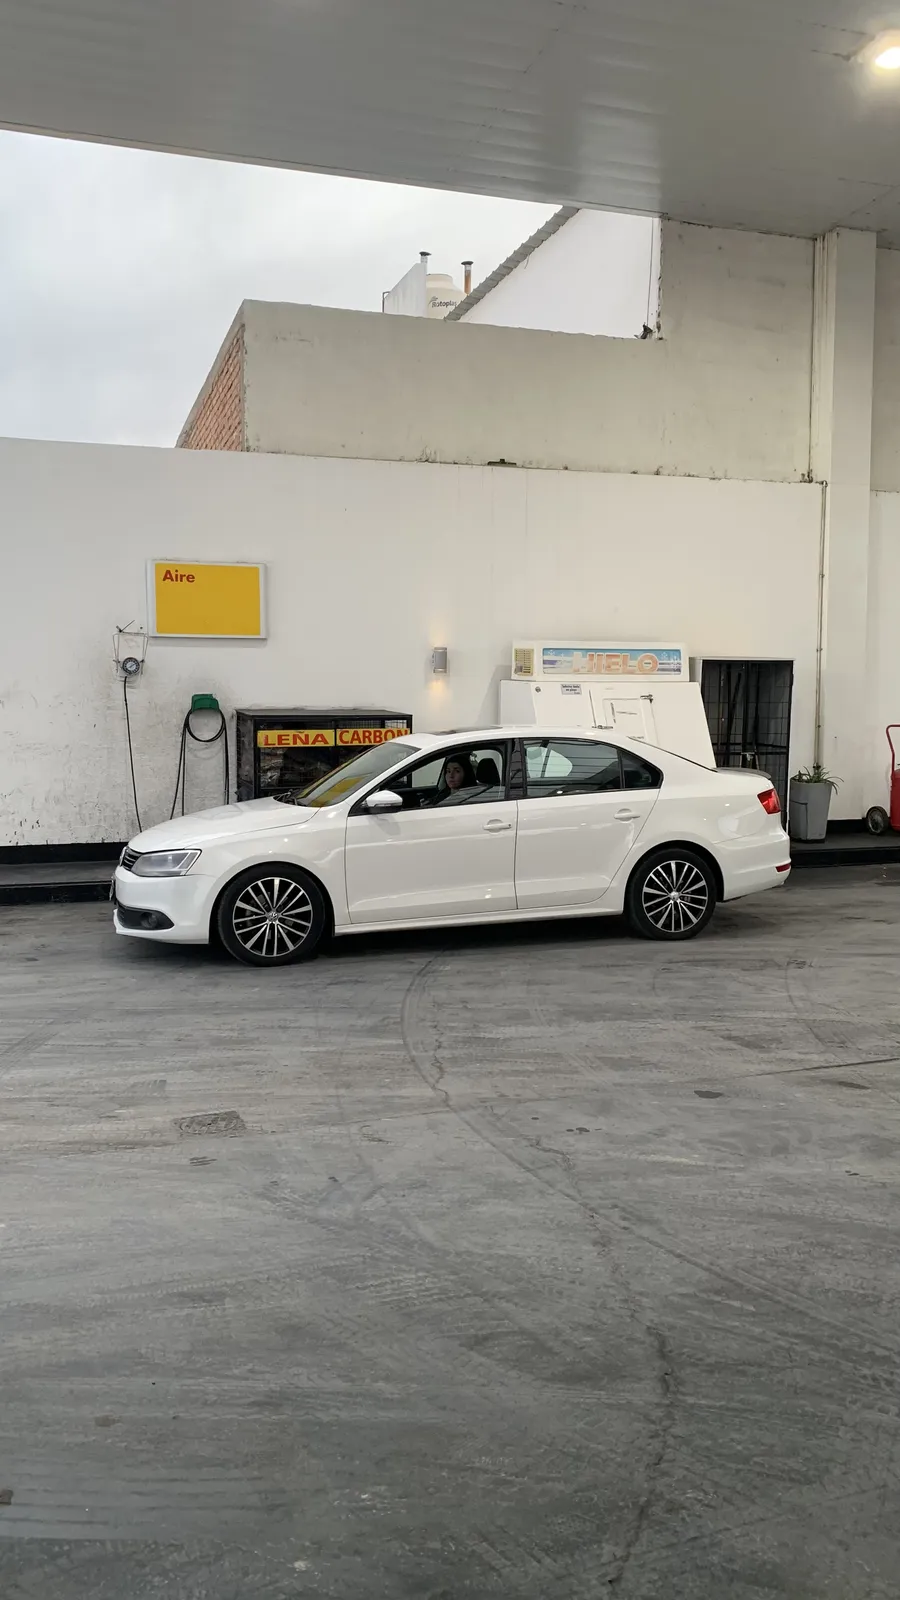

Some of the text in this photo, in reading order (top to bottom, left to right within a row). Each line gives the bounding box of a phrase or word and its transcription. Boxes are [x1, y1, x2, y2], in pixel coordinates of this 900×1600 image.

[162, 569, 195, 583] Aire
[572, 652, 659, 673] HIELO
[263, 731, 330, 746] LEÑA
